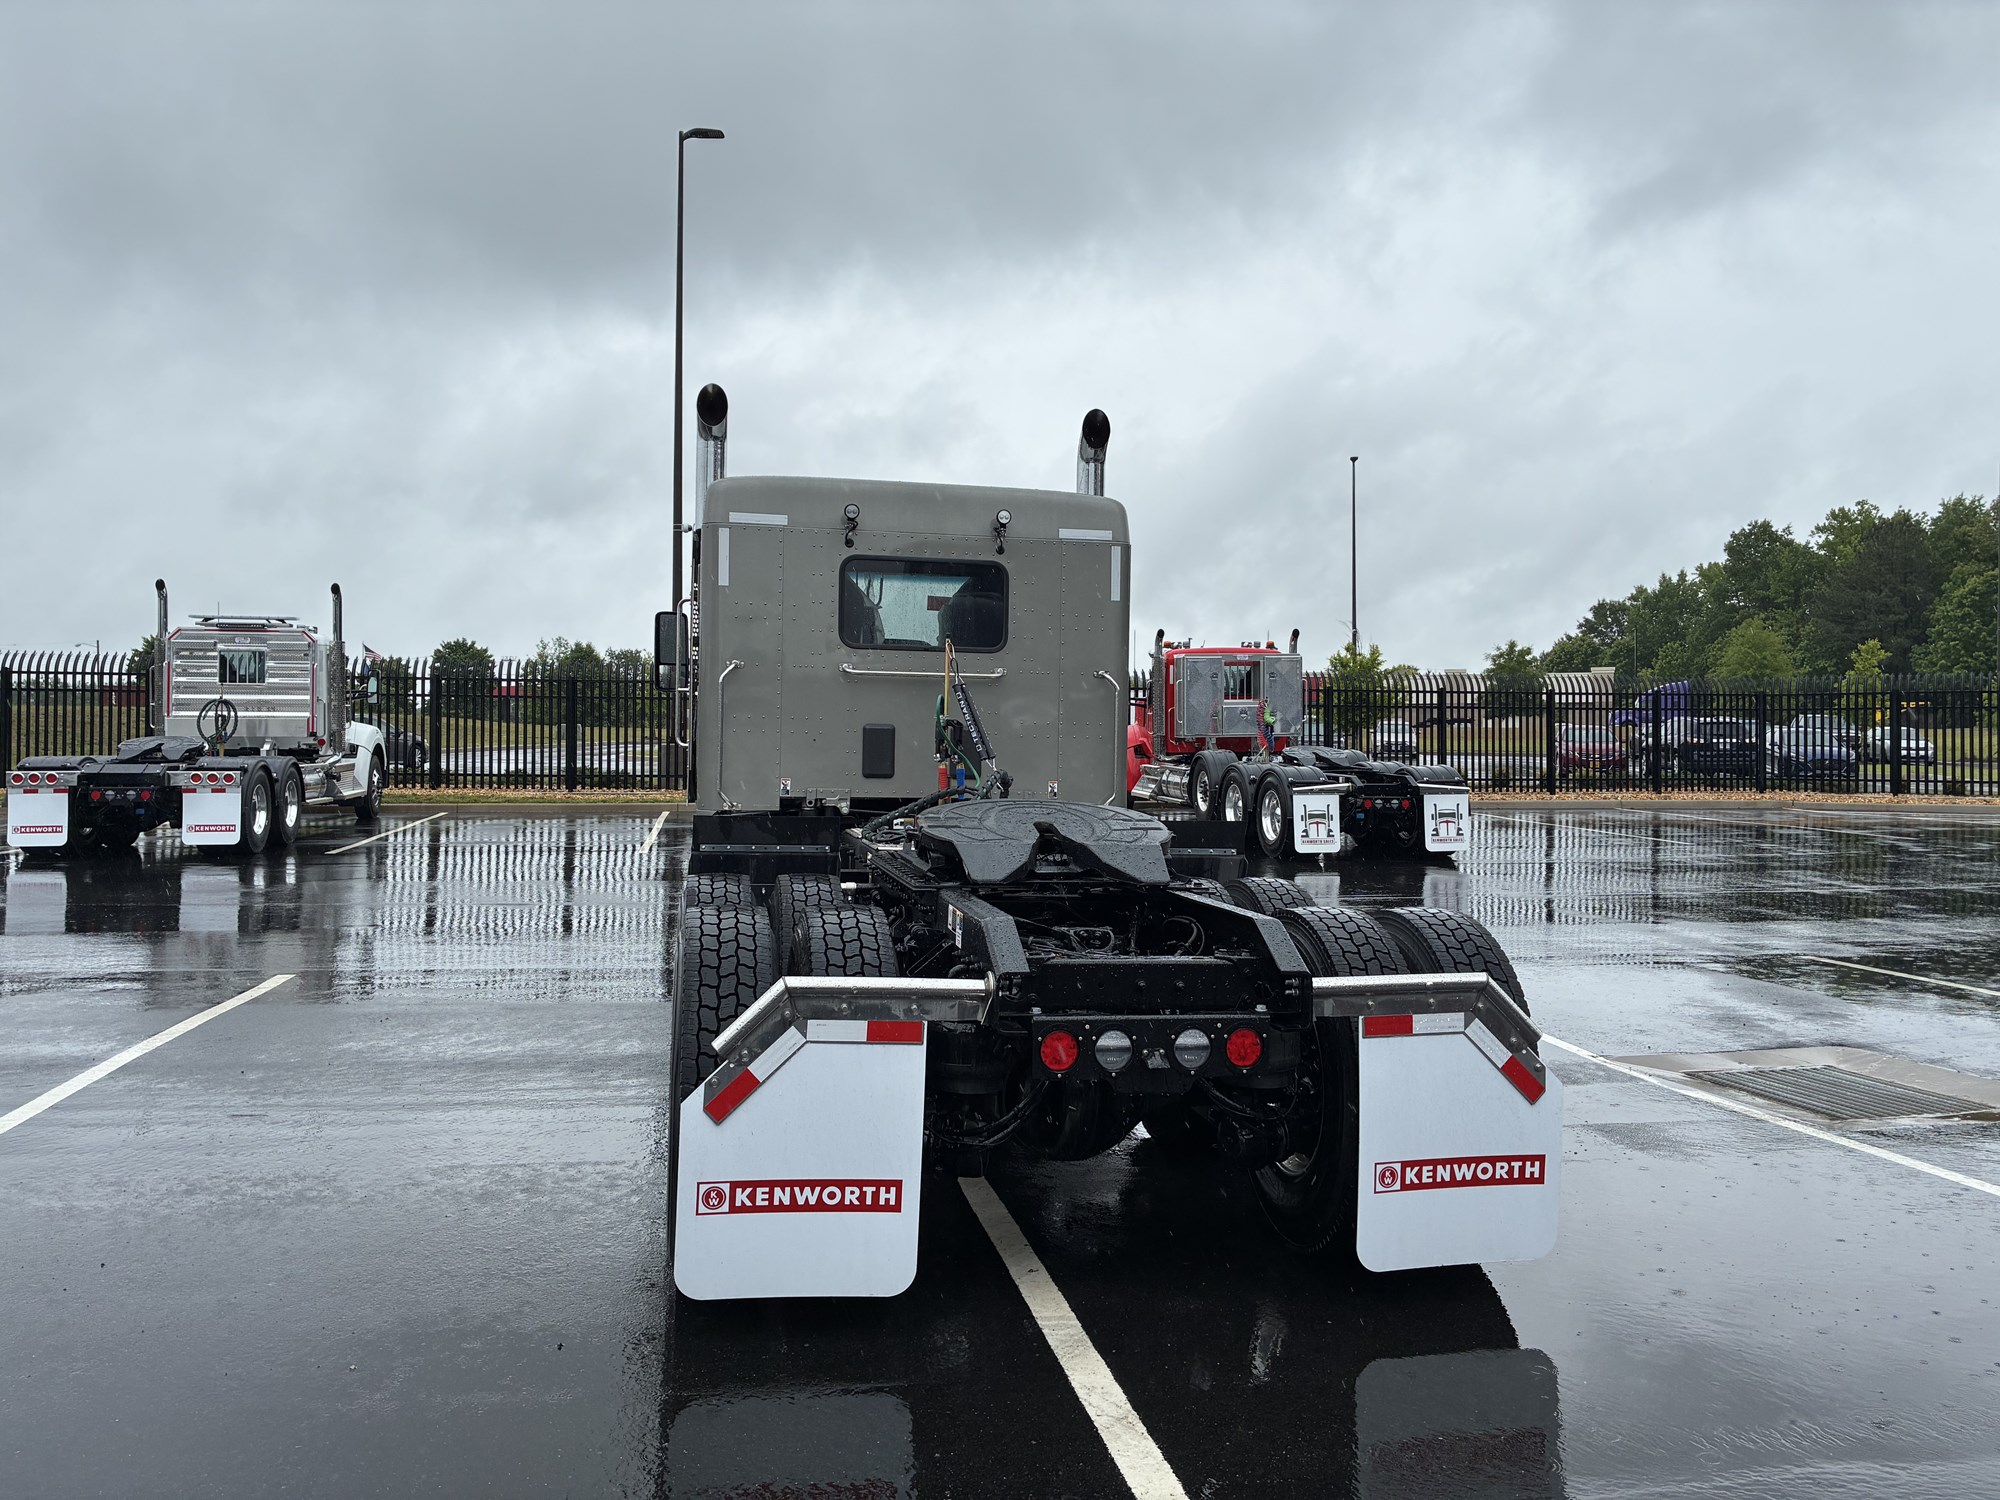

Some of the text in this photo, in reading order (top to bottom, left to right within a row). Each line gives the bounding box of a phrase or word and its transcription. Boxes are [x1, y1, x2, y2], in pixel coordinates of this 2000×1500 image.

[960, 700, 979, 744] TECTRAN
[1405, 1161, 1540, 1184] KENWORTH
[735, 1186, 896, 1206] KENWORTH
